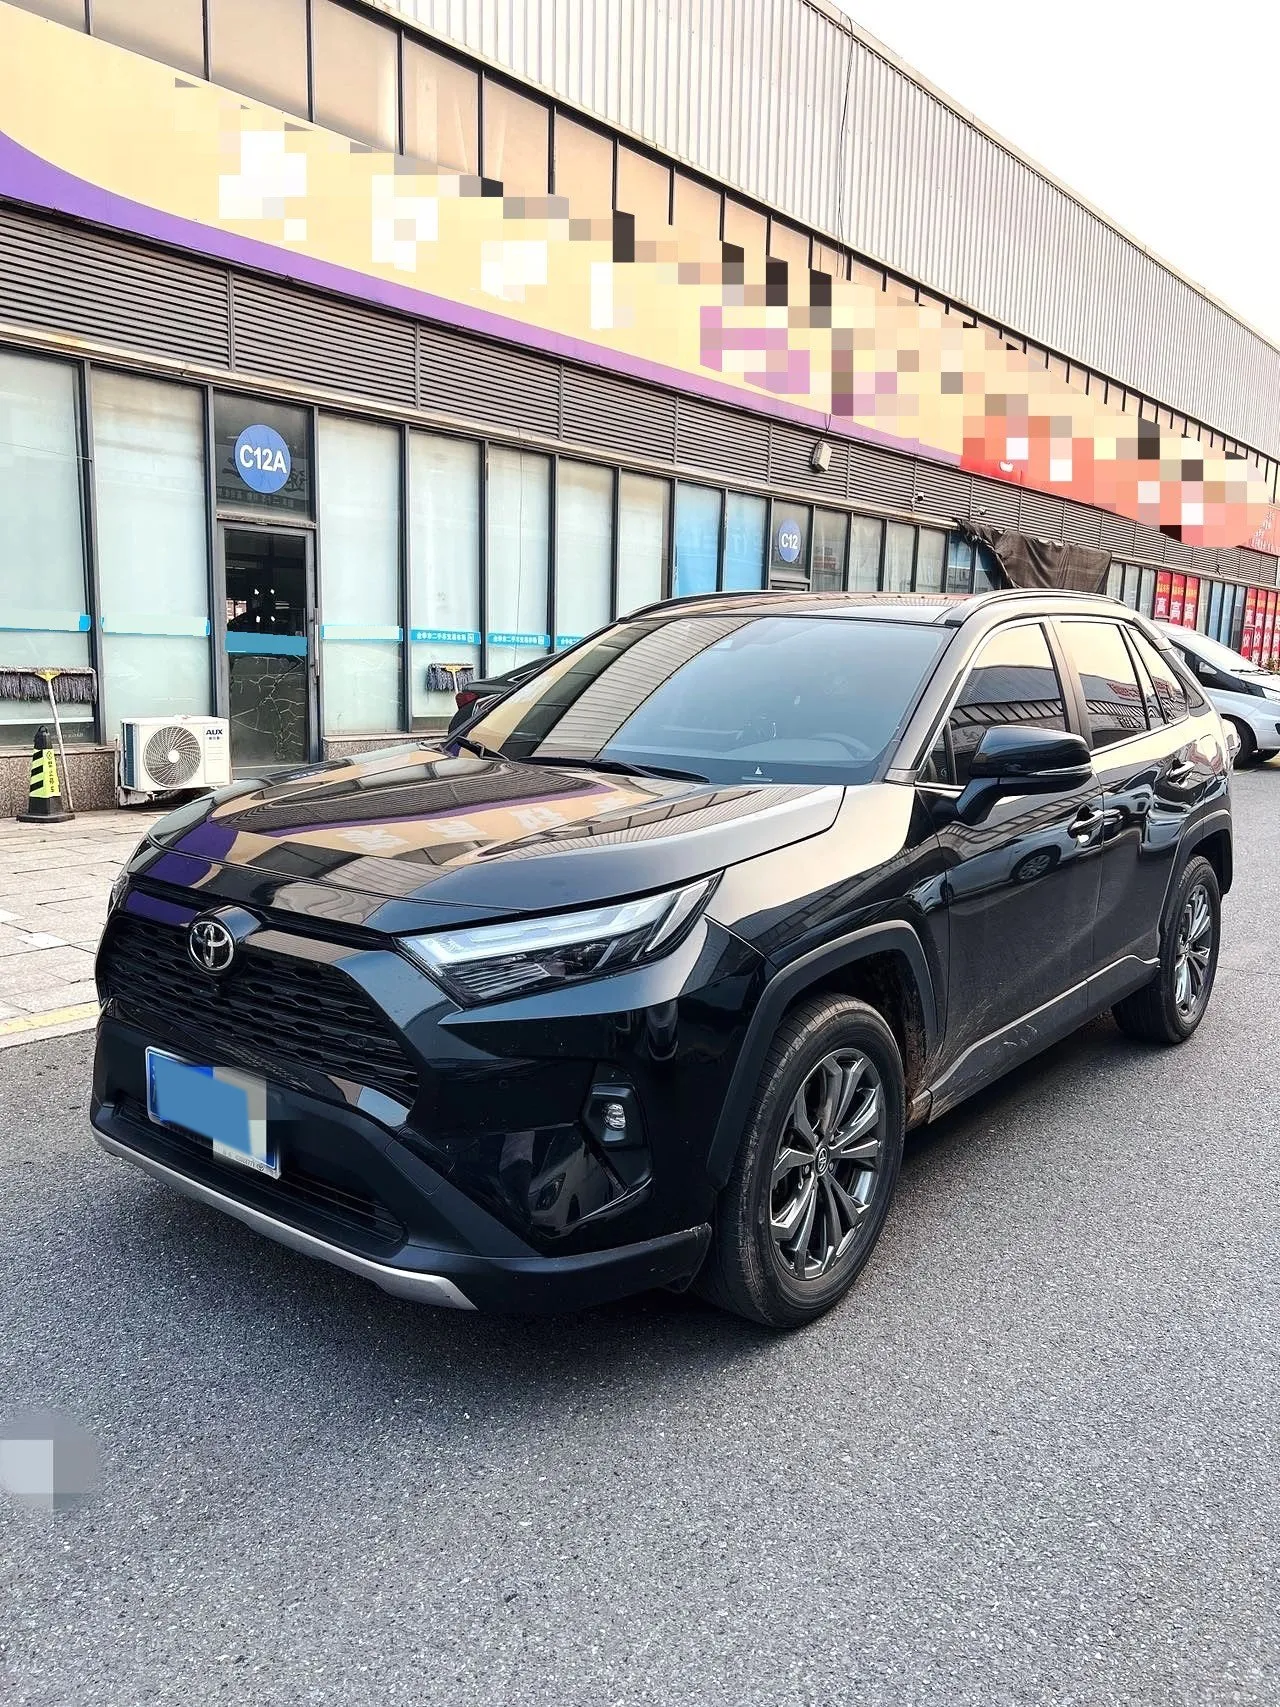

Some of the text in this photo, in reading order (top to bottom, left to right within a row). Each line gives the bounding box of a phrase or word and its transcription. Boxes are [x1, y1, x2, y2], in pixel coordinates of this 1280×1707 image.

[239, 444, 288, 474] C12A
[781, 532, 799, 550] C12
[1156, 596, 1167, 615] 高
[1170, 600, 1182, 619] 高
[206, 728, 223, 736] AUX
